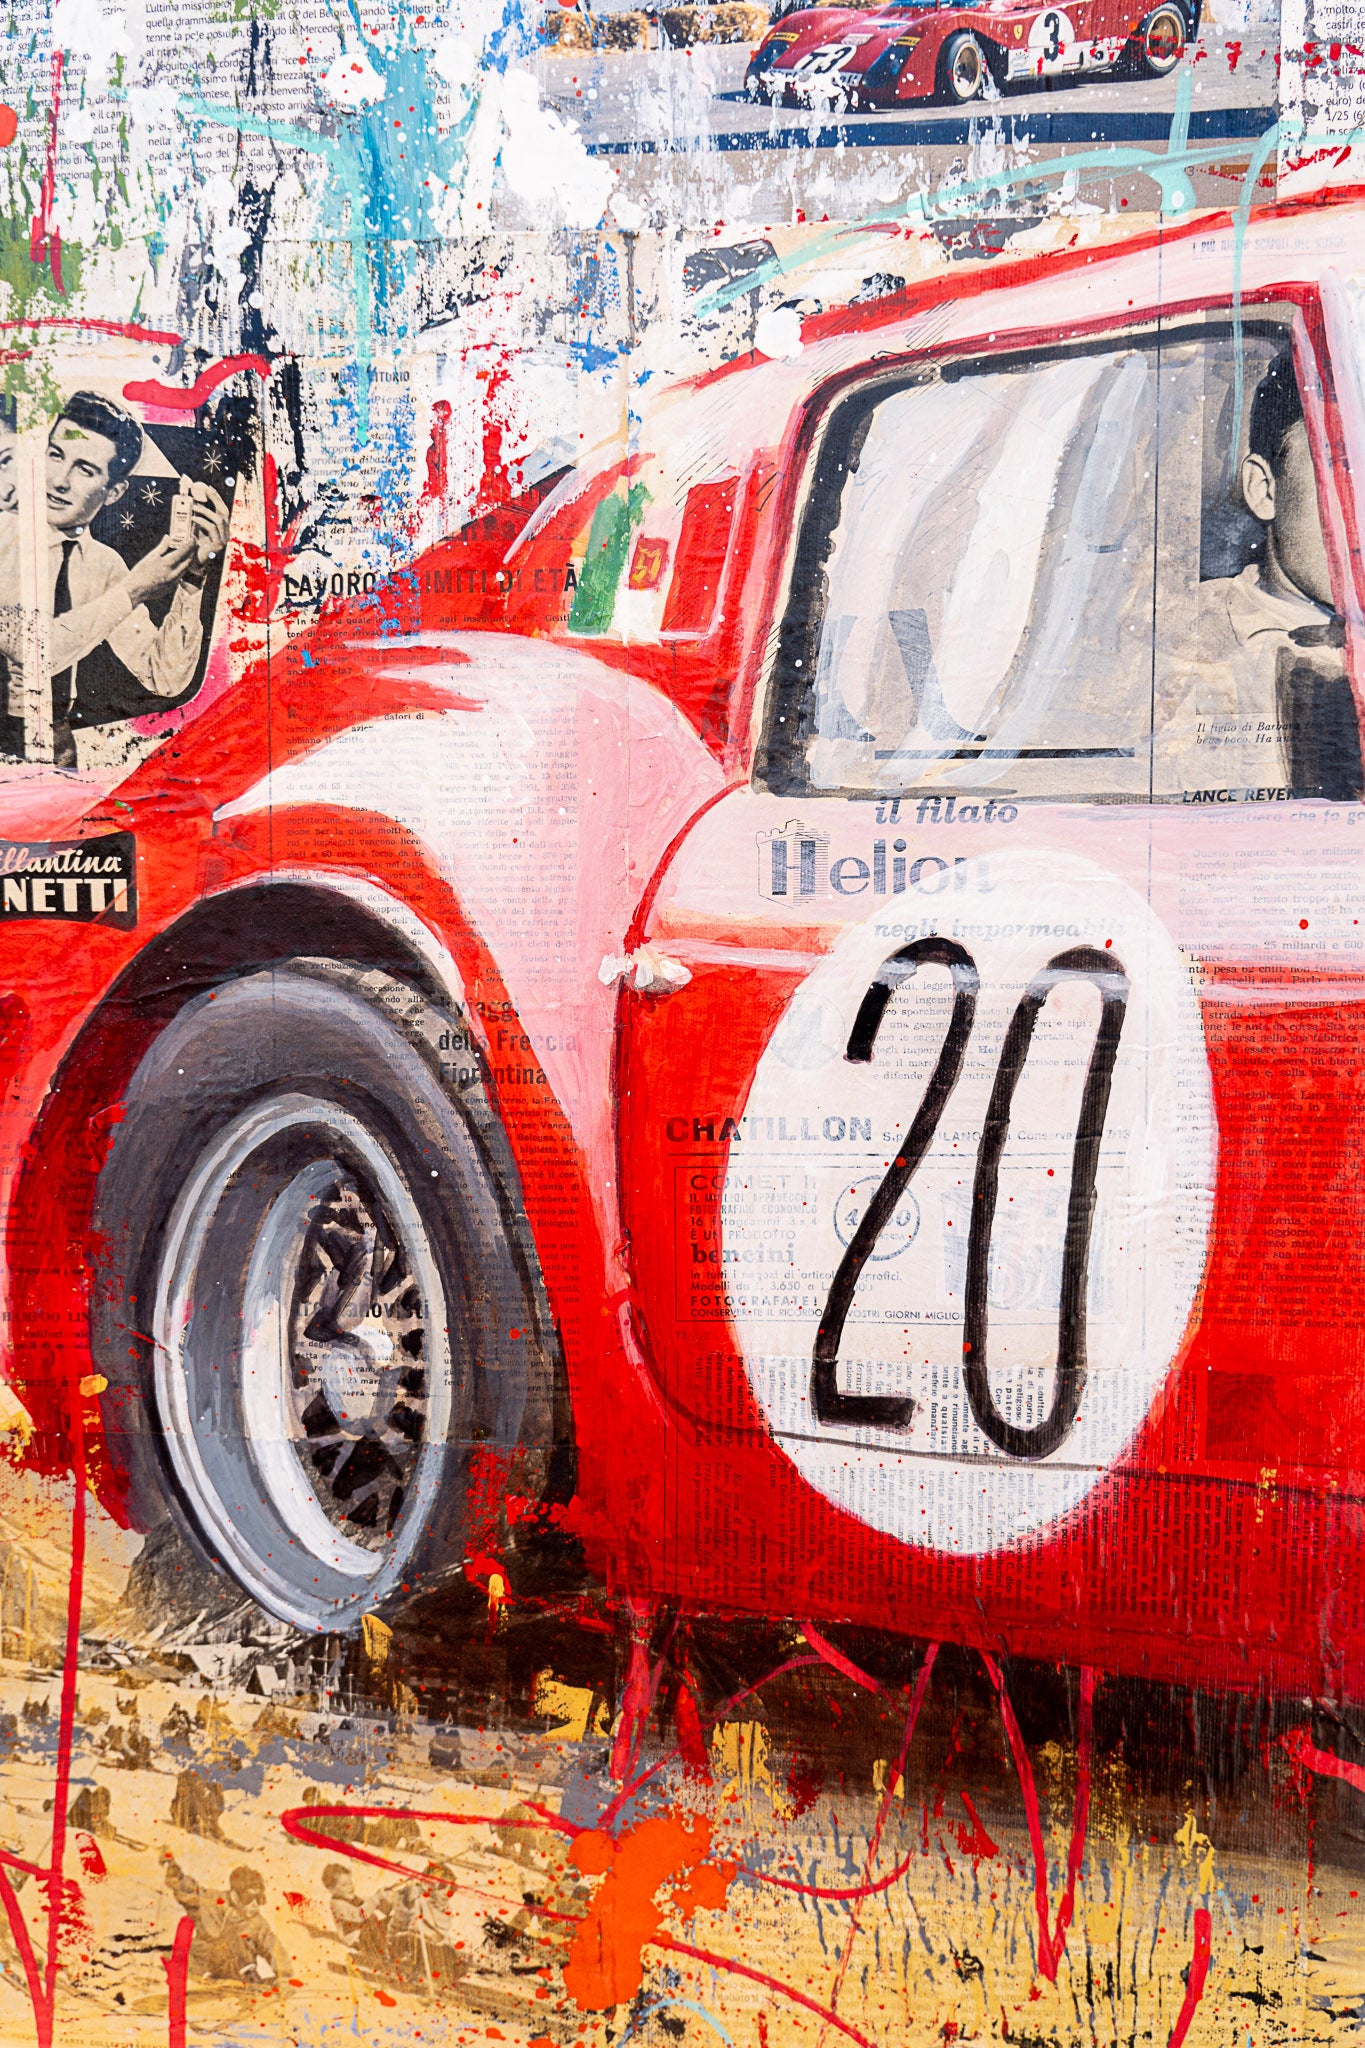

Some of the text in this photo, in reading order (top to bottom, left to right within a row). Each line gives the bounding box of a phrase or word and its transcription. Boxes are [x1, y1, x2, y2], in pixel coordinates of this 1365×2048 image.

[1044, 12, 1060, 62] 3
[800, 46, 853, 74] T3
[284, 572, 376, 597] LAVORO
[534, 562, 578, 593] ETÀ
[416, 712, 425, 720] di
[1183, 789, 1238, 803] LANCE
[874, 795, 1019, 825] il filato
[3, 877, 128, 913] NETTI
[438, 1029, 578, 1051] della Freccia
[665, 1116, 873, 1143] CHATILLON
[810, 937, 1131, 1467] 20
[690, 1242, 797, 1264] bencini
[690, 1281, 731, 1292] Modelli
[800, 1269, 835, 1280] articol
[884, 1311, 921, 1321] GIORNI
